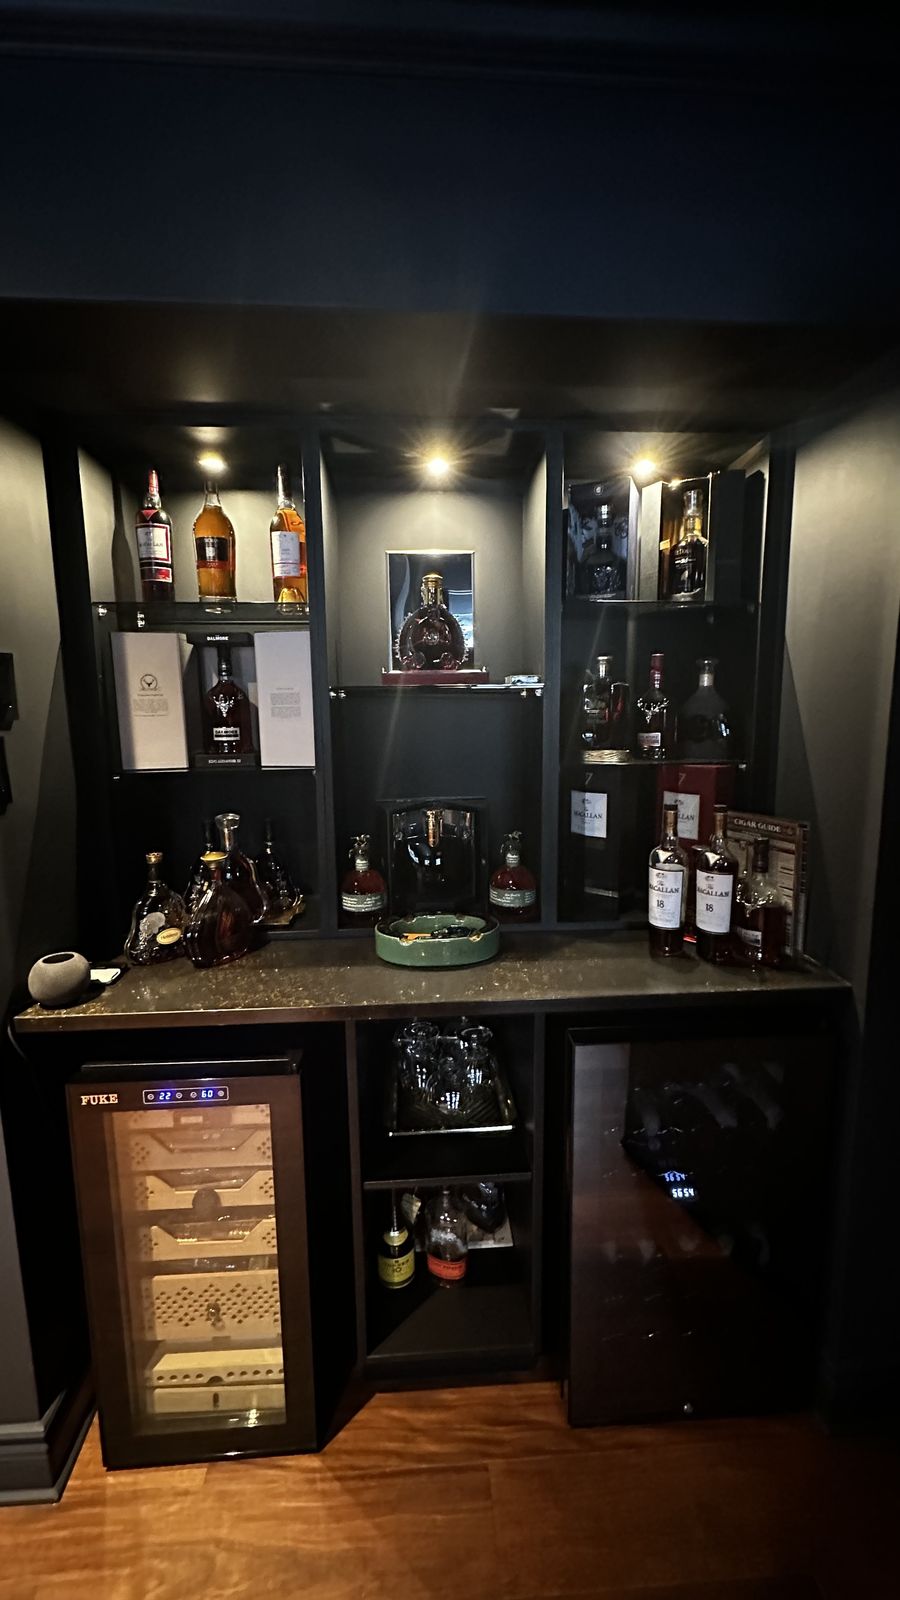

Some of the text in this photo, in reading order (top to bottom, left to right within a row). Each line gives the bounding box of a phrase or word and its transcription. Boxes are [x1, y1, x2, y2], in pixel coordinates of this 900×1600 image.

[734, 818, 781, 833] CIGAR GUIDE
[656, 899, 665, 909] 18
[705, 903, 714, 913] 18
[159, 1092, 171, 1100] 22
[201, 1090, 213, 1098] 60
[80, 1093, 118, 1106] FUKE
